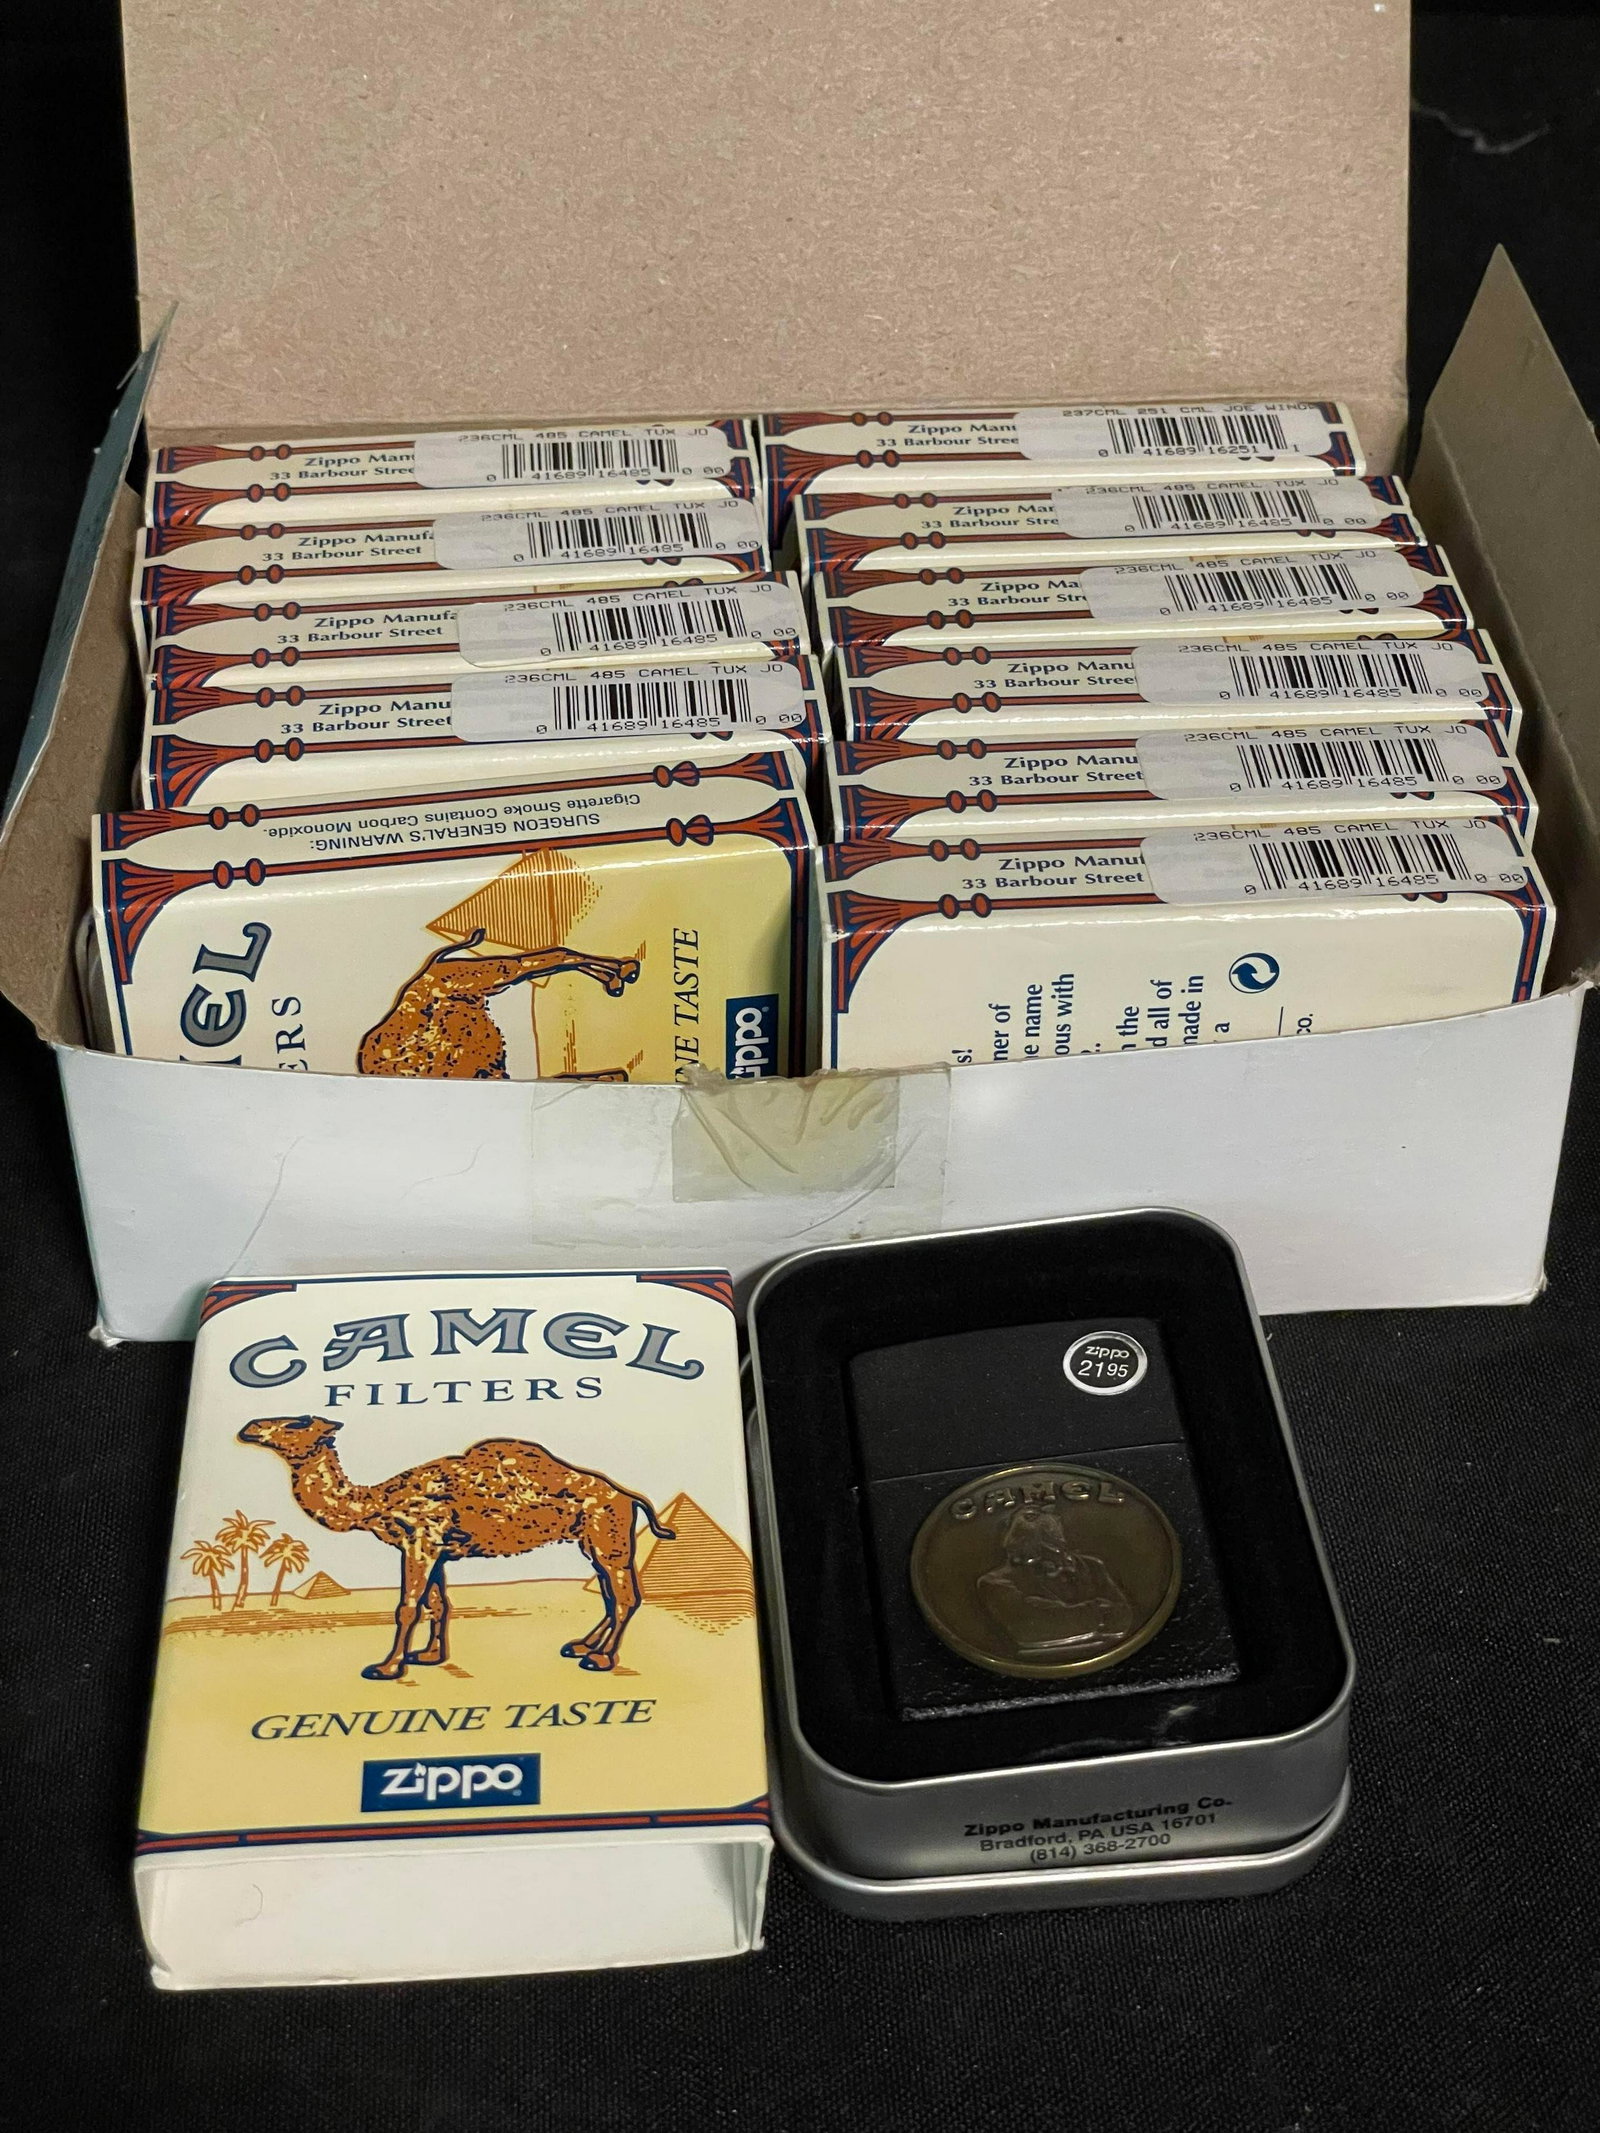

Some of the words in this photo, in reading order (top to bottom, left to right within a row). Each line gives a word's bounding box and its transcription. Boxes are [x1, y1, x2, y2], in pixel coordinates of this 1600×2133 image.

[1180, 406, 1213, 414] CML
[1223, 404, 1255, 412] JOE
[578, 429, 632, 438] CAMEL
[645, 428, 676, 437] TUX
[908, 424, 962, 435] Zippo
[877, 438, 896, 447] 33
[904, 437, 971, 446] Barbour
[978, 436, 1019, 444] Stree
[1143, 446, 1197, 456] 41689
[1209, 445, 1259, 455] 16251
[305, 456, 361, 468] Zippo
[270, 472, 291, 480] 33
[299, 468, 367, 479] Barbour
[374, 465, 415, 475] Stree
[531, 471, 586, 480] 41689
[599, 468, 651, 478] 16485
[1163, 483, 1196, 491] 485
[1207, 482, 1263, 490] CAMEL
[1274, 480, 1306, 488] TUX
[560, 508, 593, 516] 485
[605, 504, 661, 514] CAMEL
[674, 501, 705, 510] TUX
[953, 506, 1010, 517] Zippo
[921, 520, 942, 529] 33
[950, 519, 1019, 528] Barbour
[1026, 517, 1059, 525] Stre
[1170, 521, 1225, 530] 41689
[1238, 518, 1292, 528] 16485
[297, 537, 356, 548] Zippo
[560, 548, 617, 558] 41689
[629, 543, 684, 555] 16485
[262, 553, 284, 562] 33
[292, 549, 364, 560] Barbour
[370, 546, 421, 556] Street
[1114, 563, 1184, 574] 236CML
[1195, 560, 1229, 569] 485
[1240, 556, 1298, 566] CAMEL
[1310, 552, 1343, 561] TUX
[981, 582, 1039, 593] Zippo
[504, 600, 574, 611] 236CML
[586, 595, 620, 604] 485
[633, 590, 691, 601] CAMEL
[704, 586, 738, 596] TUX
[948, 597, 970, 606] 33
[977, 596, 1050, 605] Barbour
[1208, 601, 1264, 612] 41689
[1277, 596, 1333, 608] 16485
[314, 616, 375, 629] Zippo
[277, 634, 300, 644] 33
[308, 631, 383, 642] Barbour
[389, 626, 443, 638] Street
[590, 640, 648, 651] 41689
[661, 634, 718, 647] 16485
[1178, 644, 1250, 653] 236CML
[1262, 643, 1298, 651] 485
[1310, 642, 1370, 650] CAMEL
[1382, 641, 1418, 649] TUX
[504, 673, 577, 683] 236CML
[590, 670, 626, 680] 485
[639, 667, 698, 678] CAMEL
[712, 665, 747, 674] TUX
[1008, 663, 1069, 675] Zippo
[974, 679, 997, 689] 33
[1004, 677, 1080, 688] Barbour
[1269, 689, 1330, 699] 41689
[1342, 688, 1402, 698] 16485
[318, 704, 382, 717] Zippo
[281, 723, 304, 734] 33
[312, 720, 390, 732] Barbour
[397, 716, 452, 727] Street
[587, 720, 648, 732] 41689
[662, 717, 721, 729] 16485
[1184, 732, 1258, 742] 236CML
[1271, 729, 1307, 738] 485
[1320, 727, 1382, 737] CAMEL
[1393, 725, 1431, 734] TUX
[1003, 756, 1068, 771] Zippo
[969, 776, 993, 786] 33
[1001, 774, 1079, 785] Barbour
[1086, 771, 1145, 782] Street
[1282, 779, 1343, 790] 41689
[1358, 776, 1418, 787] 16485
[504, 801, 561, 815] Smoke
[567, 793, 642, 809] Cigarette
[358, 815, 419, 829] Carbon
[425, 807, 497, 823] Contains
[513, 813, 600, 832] SURGEON
[263, 821, 351, 838] Monoxide.
[410, 822, 506, 842] GENERAL'S
[1193, 830, 1270, 842] 236CML
[1283, 825, 1321, 836] 485
[1334, 822, 1398, 834] CAMEL
[1411, 820, 1449, 830] TUX
[310, 833, 404, 851] WARNING:
[998, 857, 1065, 872] Zippo
[962, 878, 987, 889] 33
[995, 875, 1077, 888] Barbour
[1084, 872, 1145, 884] Street
[1298, 878, 1362, 891] 41689
[1376, 874, 1439, 887] 16485
[673, 927, 699, 1026] TASTE
[1180, 975, 1204, 993] in
[1051, 973, 1074, 1017] with
[1150, 979, 1172, 999] of
[988, 1003, 1011, 1023] of
[1025, 984, 1043, 1037] name
[1147, 1007, 1170, 1029] all
[1115, 1006, 1140, 1036] the
[993, 1030, 1010, 1061] ner
[1054, 1023, 1071, 1055] ous
[951, 1049, 973, 1064] s!
[229, 1307, 705, 1389] CAMEL
[1077, 1359, 1129, 1378] 2195
[324, 1376, 604, 1407] FILTERS
[950, 1480, 1125, 1519] CAMEL
[250, 1705, 491, 1740] GENUINE
[504, 1698, 657, 1729] TASTE
[964, 1821, 1025, 1837] Zippo
[1032, 1802, 1190, 1830] Manufacturing
[1196, 1796, 1232, 1810] Co.
[979, 1832, 1073, 1852] Bradford,
[1078, 1825, 1105, 1841] PA
[1111, 1821, 1155, 1837] USA
[1161, 1812, 1216, 1830] 16701
[1030, 1845, 1077, 1864] (814)
[1084, 1833, 1171, 1856] 368-2700
